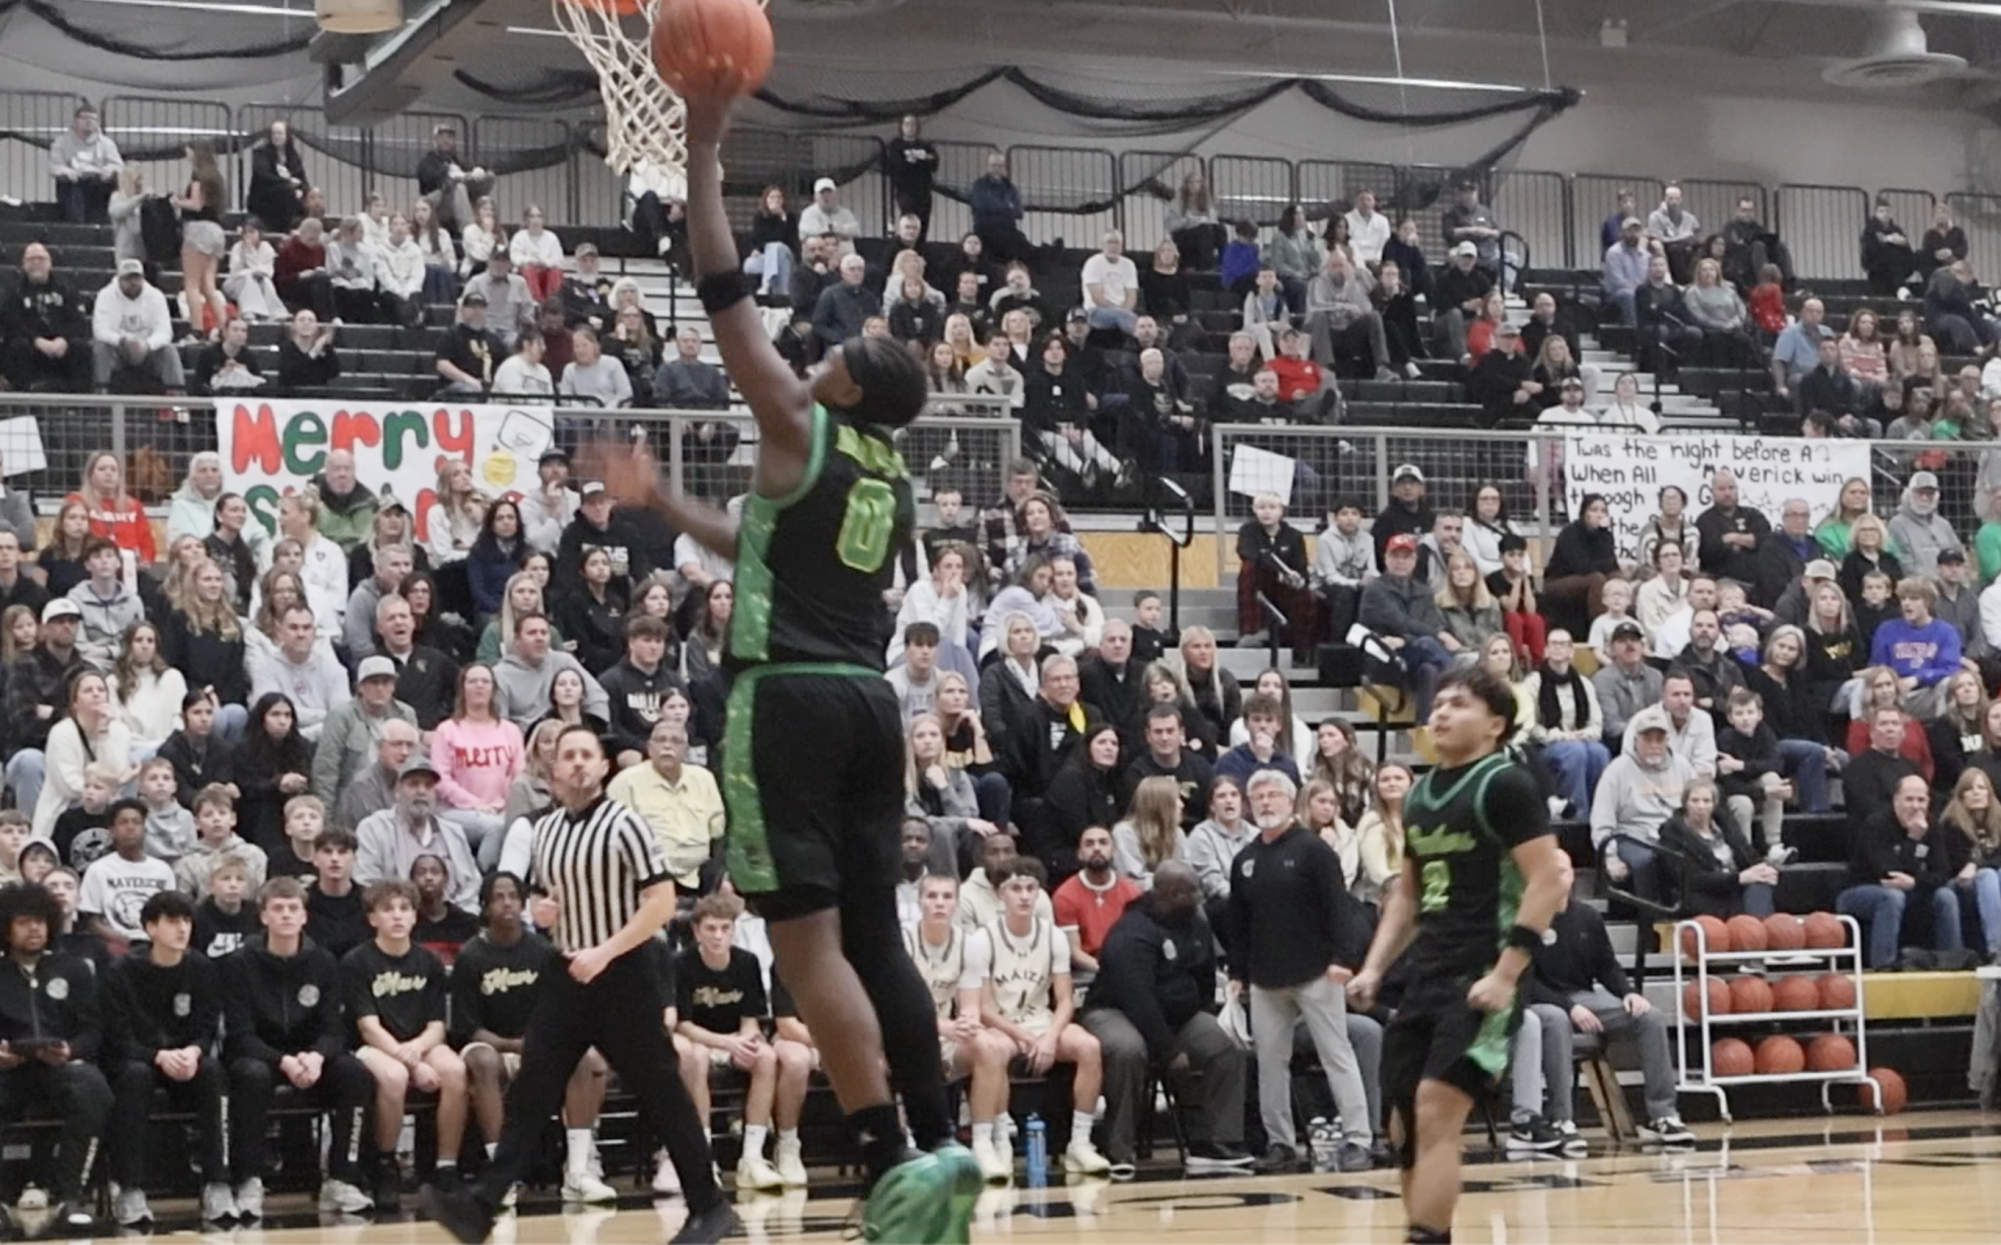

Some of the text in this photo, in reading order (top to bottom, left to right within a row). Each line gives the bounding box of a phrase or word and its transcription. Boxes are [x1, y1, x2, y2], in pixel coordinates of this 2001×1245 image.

[231, 403, 474, 475] Merry
[1622, 438, 1658, 459] the
[1671, 439, 1722, 469] night
[1733, 439, 1792, 463] before
[1801, 445, 1812, 463] A
[1571, 464, 1656, 484] When All
[1812, 469, 1844, 485] win
[836, 477, 896, 573] 0
[449, 743, 515, 777] merry
